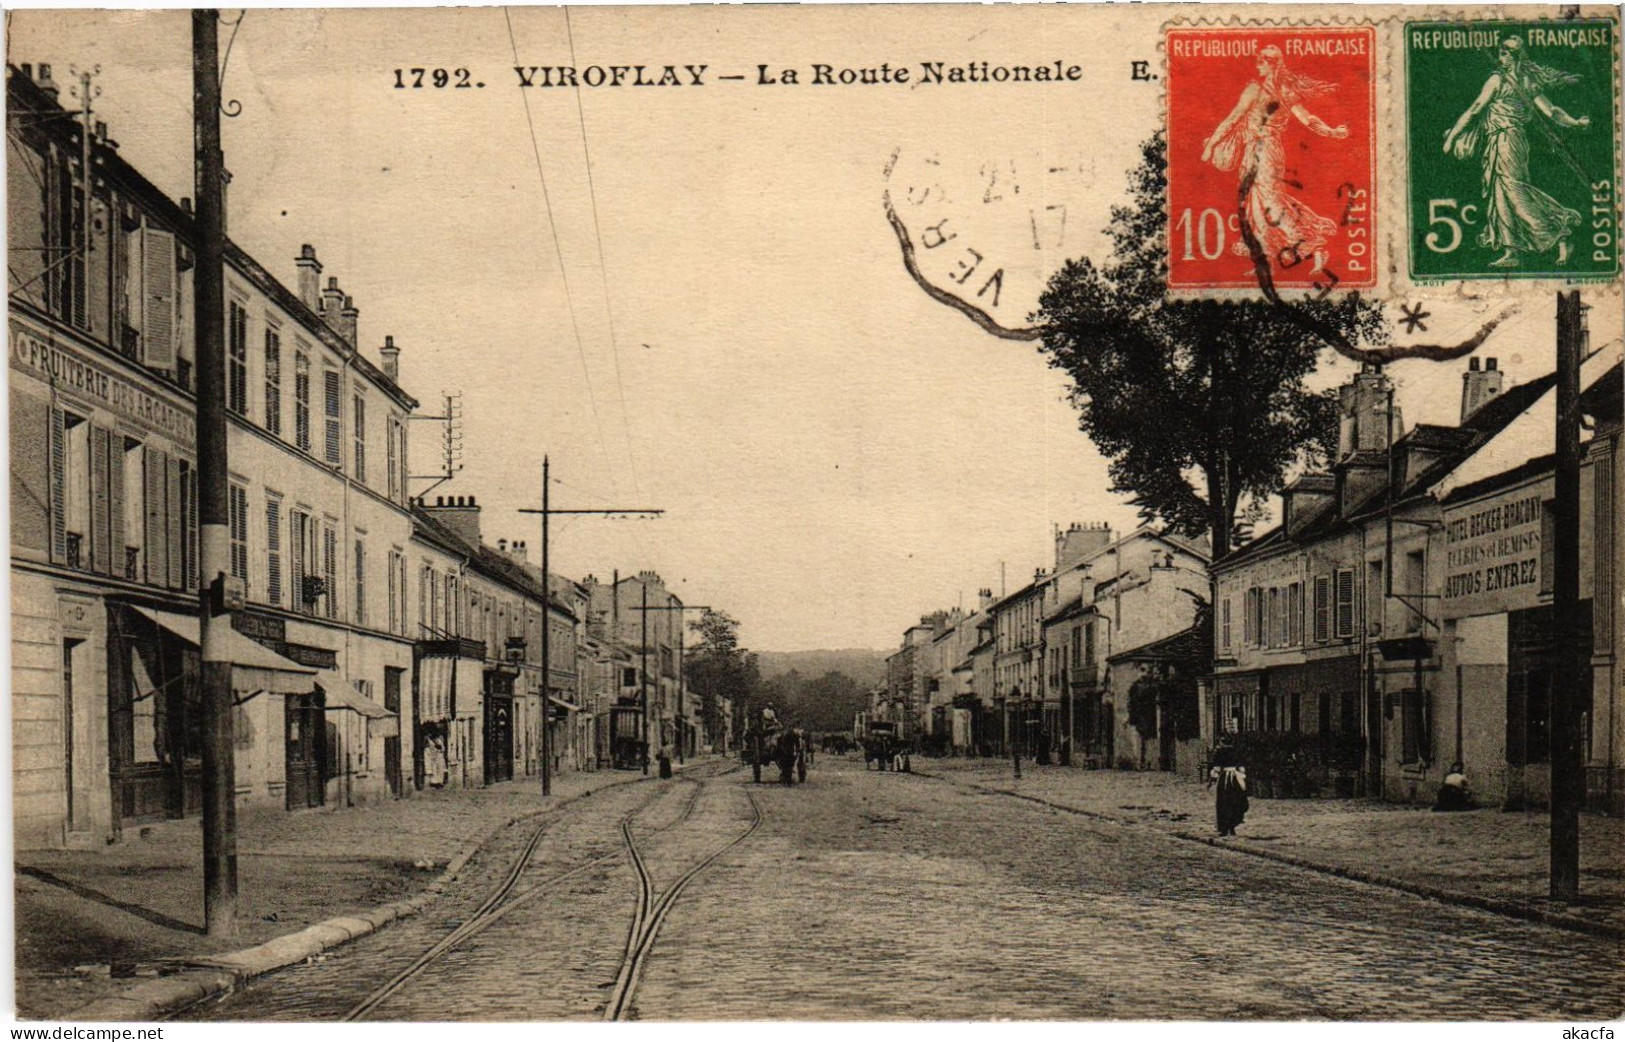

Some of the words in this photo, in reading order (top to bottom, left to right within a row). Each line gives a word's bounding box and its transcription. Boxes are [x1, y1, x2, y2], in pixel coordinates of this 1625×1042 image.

[1285, 37, 1366, 58] FRANÇAISE
[1527, 28, 1609, 49] FRANÇAISE
[1348, 188, 1367, 271] POSTES
[1591, 179, 1612, 262] POSTES
[29, 338, 110, 400] FRUITERIE
[1445, 569, 1482, 599] AUTOS
[1485, 557, 1537, 592] ENTREZ
